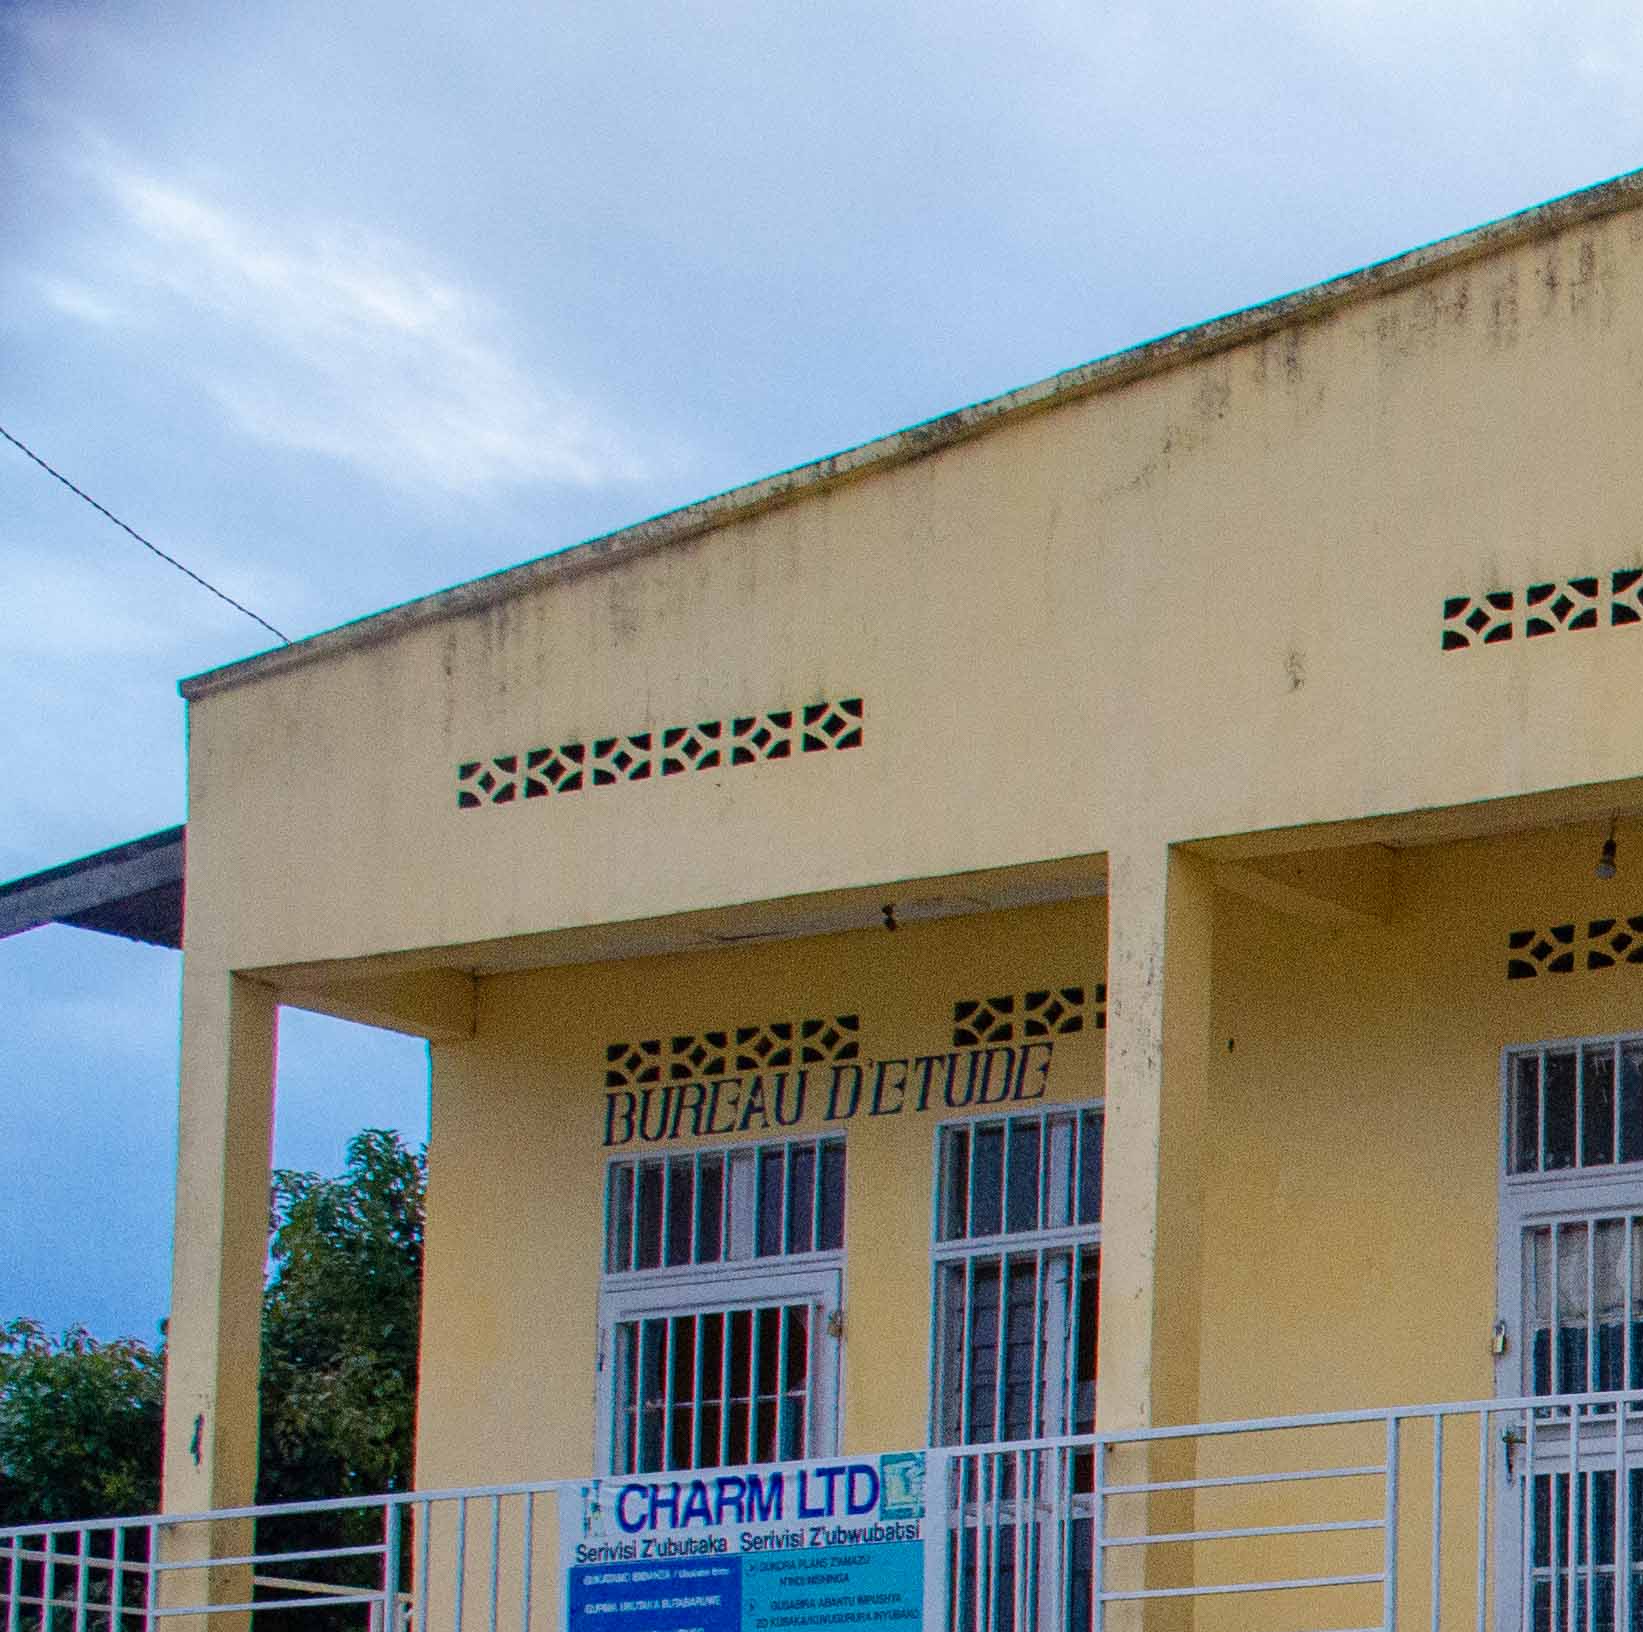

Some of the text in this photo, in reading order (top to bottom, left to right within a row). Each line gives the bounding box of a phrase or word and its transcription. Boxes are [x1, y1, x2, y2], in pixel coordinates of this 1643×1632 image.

[603, 1041, 1055, 1147] BUREAU D'ETUDE
[616, 1463, 879, 1534] CHARM LTD
[576, 1532, 729, 1563] Serivisi Z'ubutaka
[739, 1520, 920, 1552] Serivisi Z'ubwubatsi
